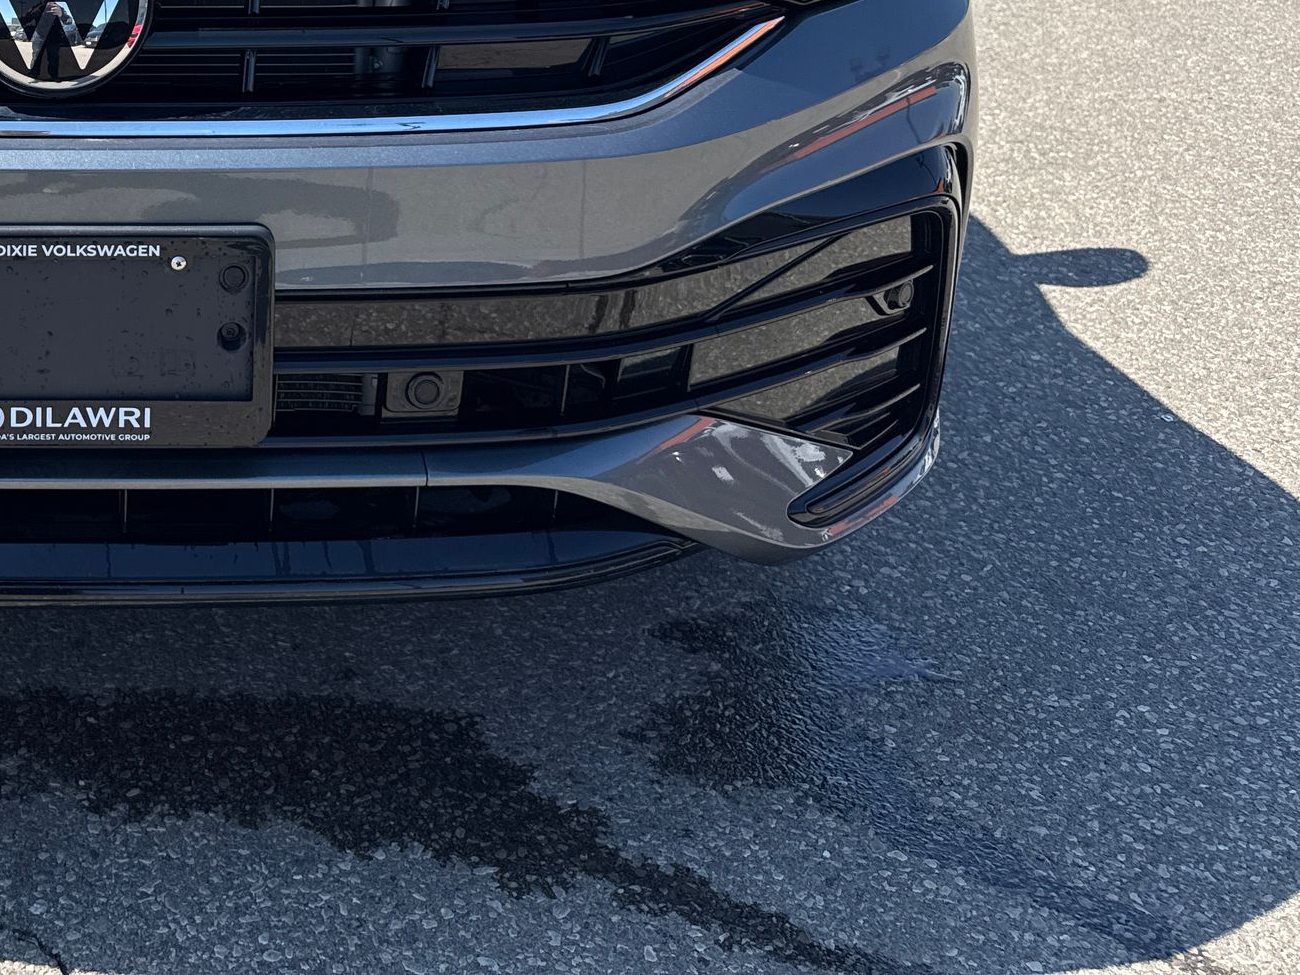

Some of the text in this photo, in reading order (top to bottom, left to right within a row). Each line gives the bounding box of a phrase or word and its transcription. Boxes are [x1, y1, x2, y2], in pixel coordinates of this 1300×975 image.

[41, 244, 160, 257] VOLKSWAGEN
[10, 407, 151, 428] DILAWRI
[16, 433, 56, 441] LARGEST
[58, 433, 116, 441] AUTOMOTIVE
[118, 433, 151, 441] GROUP
